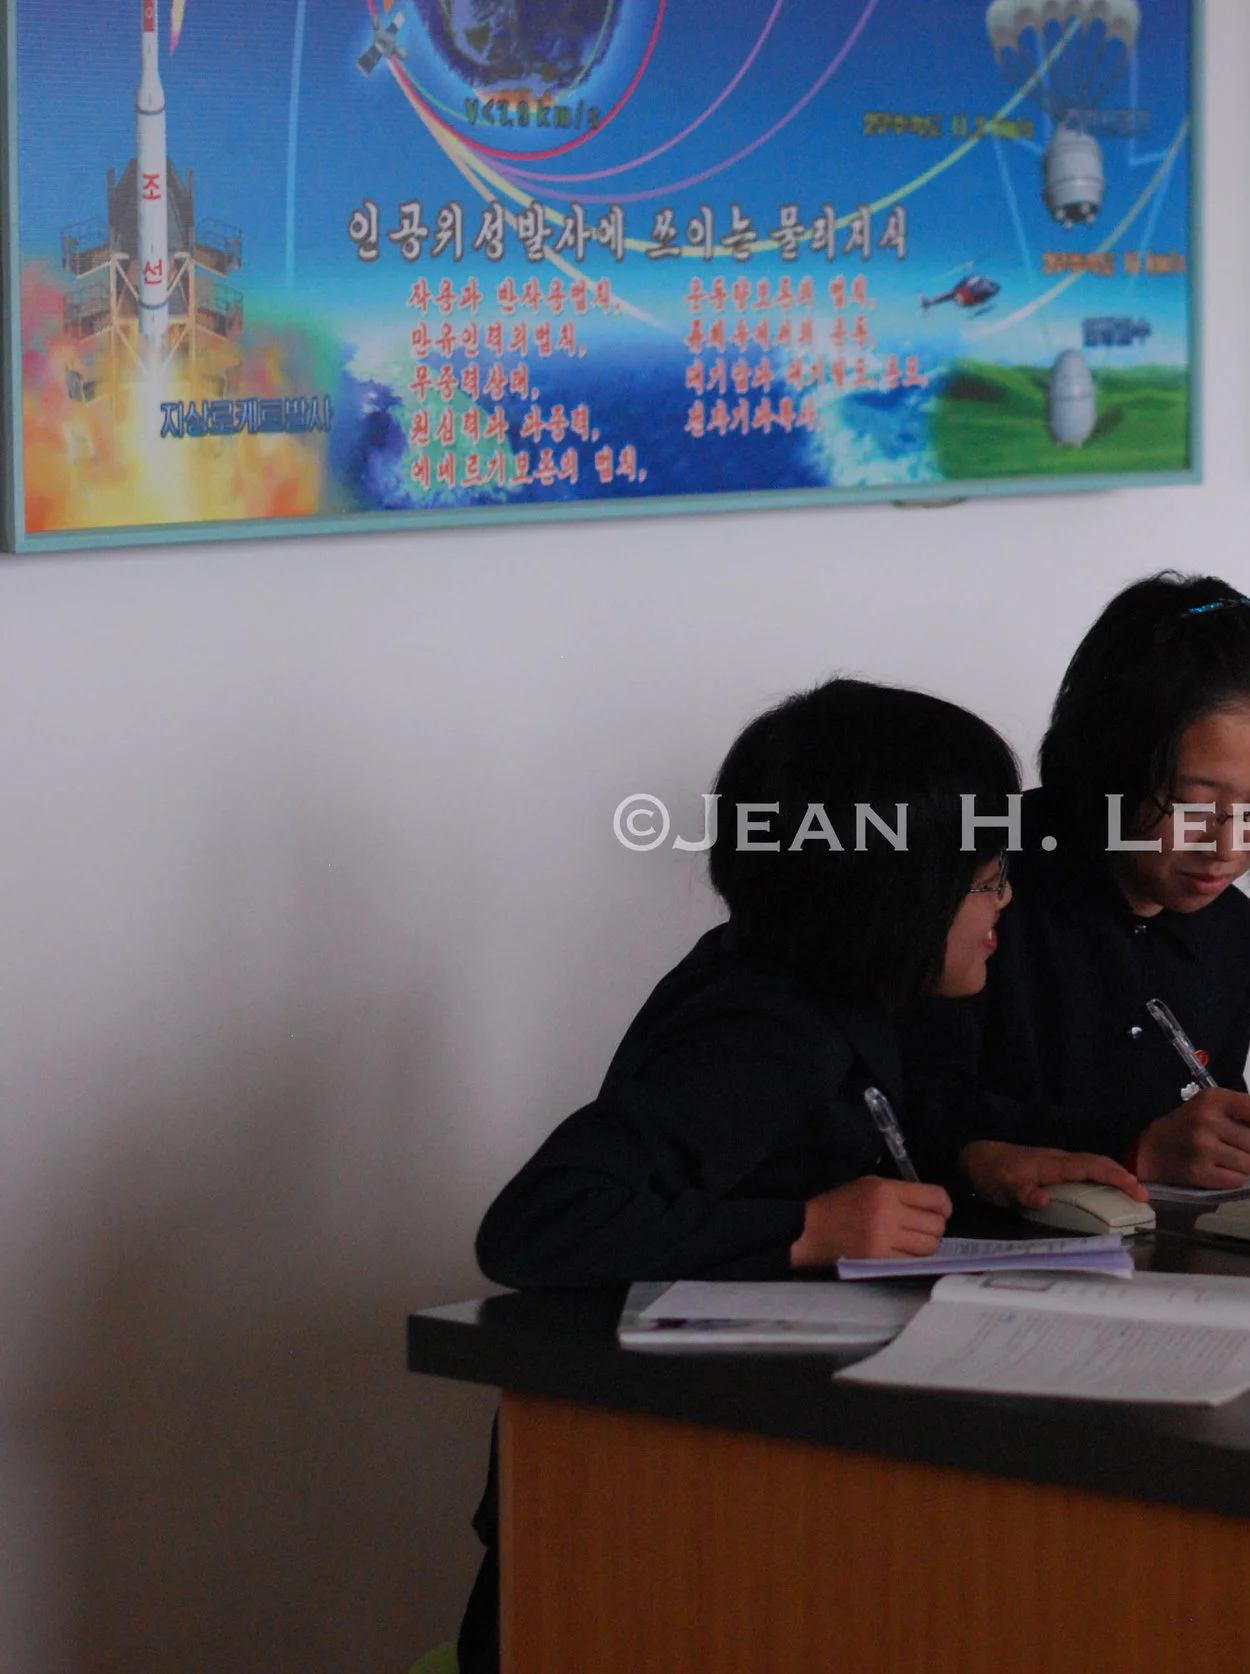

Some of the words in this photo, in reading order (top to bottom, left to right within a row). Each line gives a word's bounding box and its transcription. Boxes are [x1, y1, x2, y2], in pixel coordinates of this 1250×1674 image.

[348, 199, 626, 263] 인공위성발사에
[646, 203, 758, 262] 쓰이는
[407, 276, 482, 313] 작용과
[408, 362, 540, 401] 무중력상태,
[594, 444, 648, 484] 법칙,
